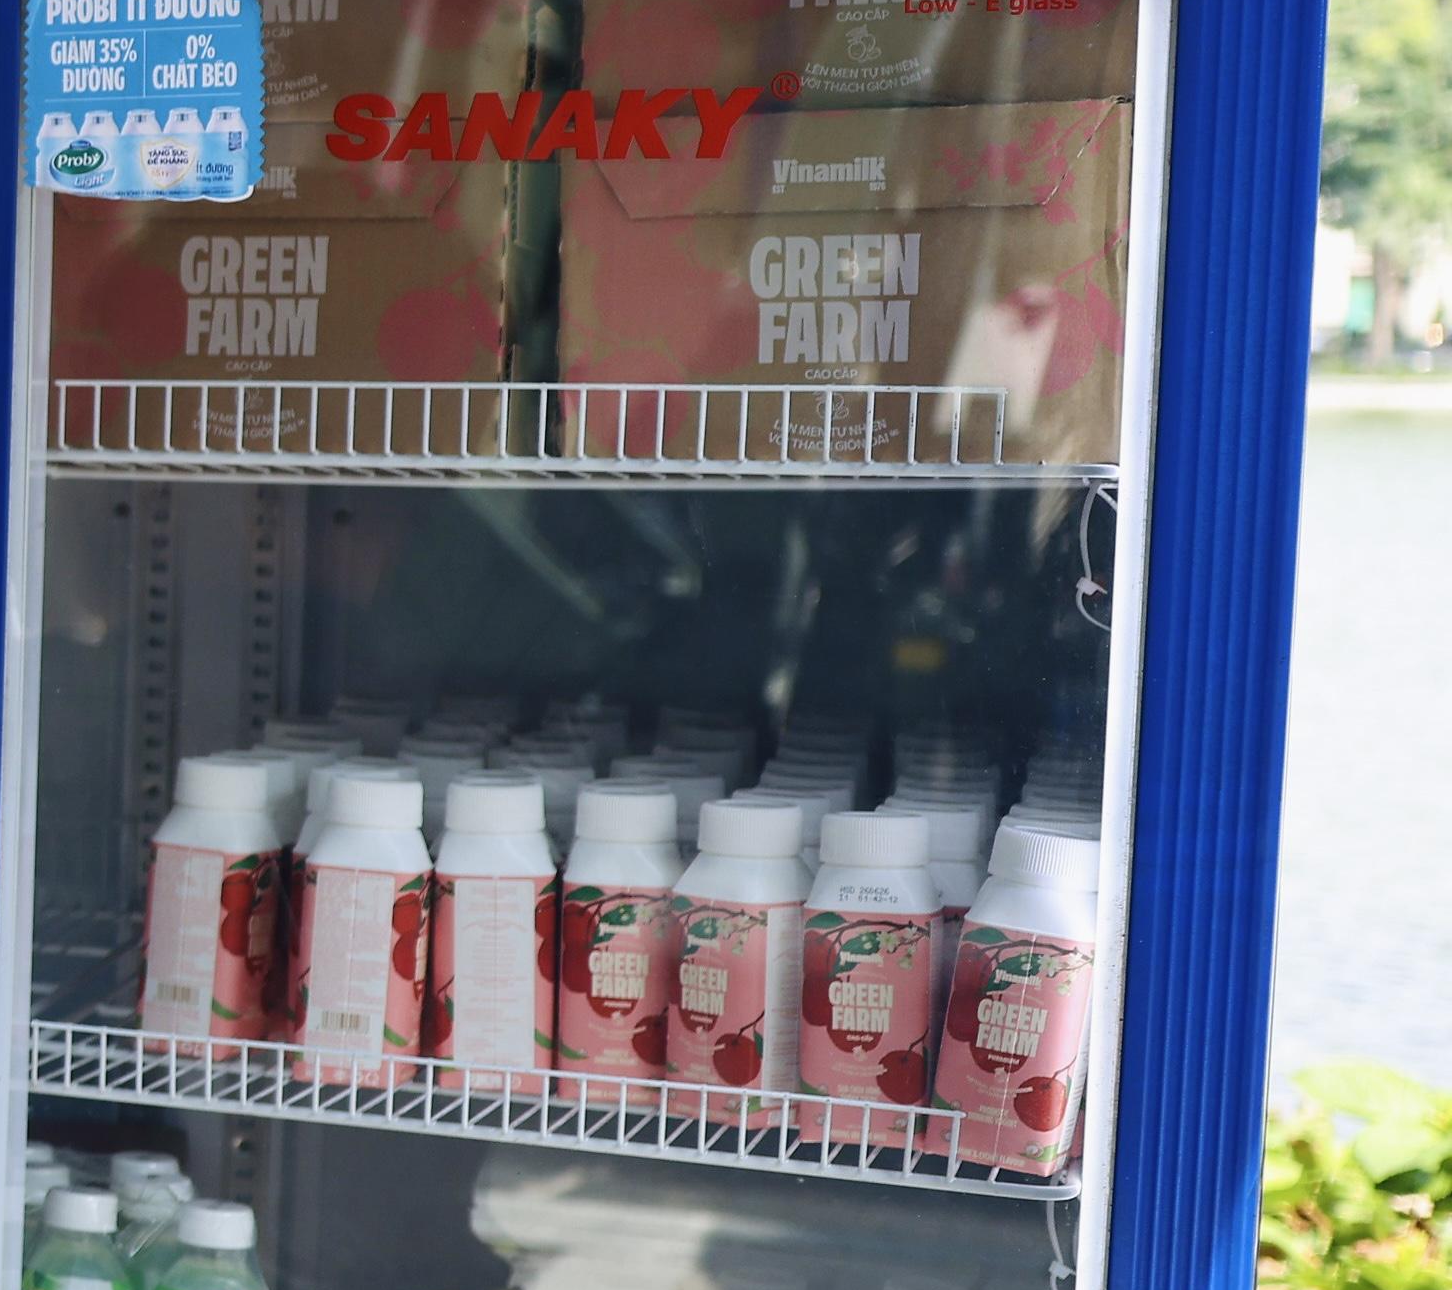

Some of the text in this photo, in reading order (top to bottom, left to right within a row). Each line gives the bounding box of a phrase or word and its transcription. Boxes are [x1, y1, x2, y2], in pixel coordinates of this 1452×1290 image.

[836, 10, 863, 22] CAO
[50, 36, 138, 65] GIẢM 35%
[186, 34, 216, 60] 0%
[325, 86, 766, 161] SANAKY
[773, 156, 886, 183] Vinamilk
[180, 236, 330, 295] GREEN
[749, 233, 922, 299] GREEN
[185, 298, 320, 357] FARM
[758, 300, 911, 365] FARM
[805, 369, 831, 380] CAO
[588, 951, 650, 975] GREEN
[679, 962, 729, 993] GREEN
[591, 973, 646, 999] FARM
[828, 980, 894, 1009] GREEN
[681, 987, 726, 1016] FARM
[976, 997, 1049, 1034] GREEN
[831, 1006, 891, 1034] FARM
[975, 1023, 1041, 1058] FARM
